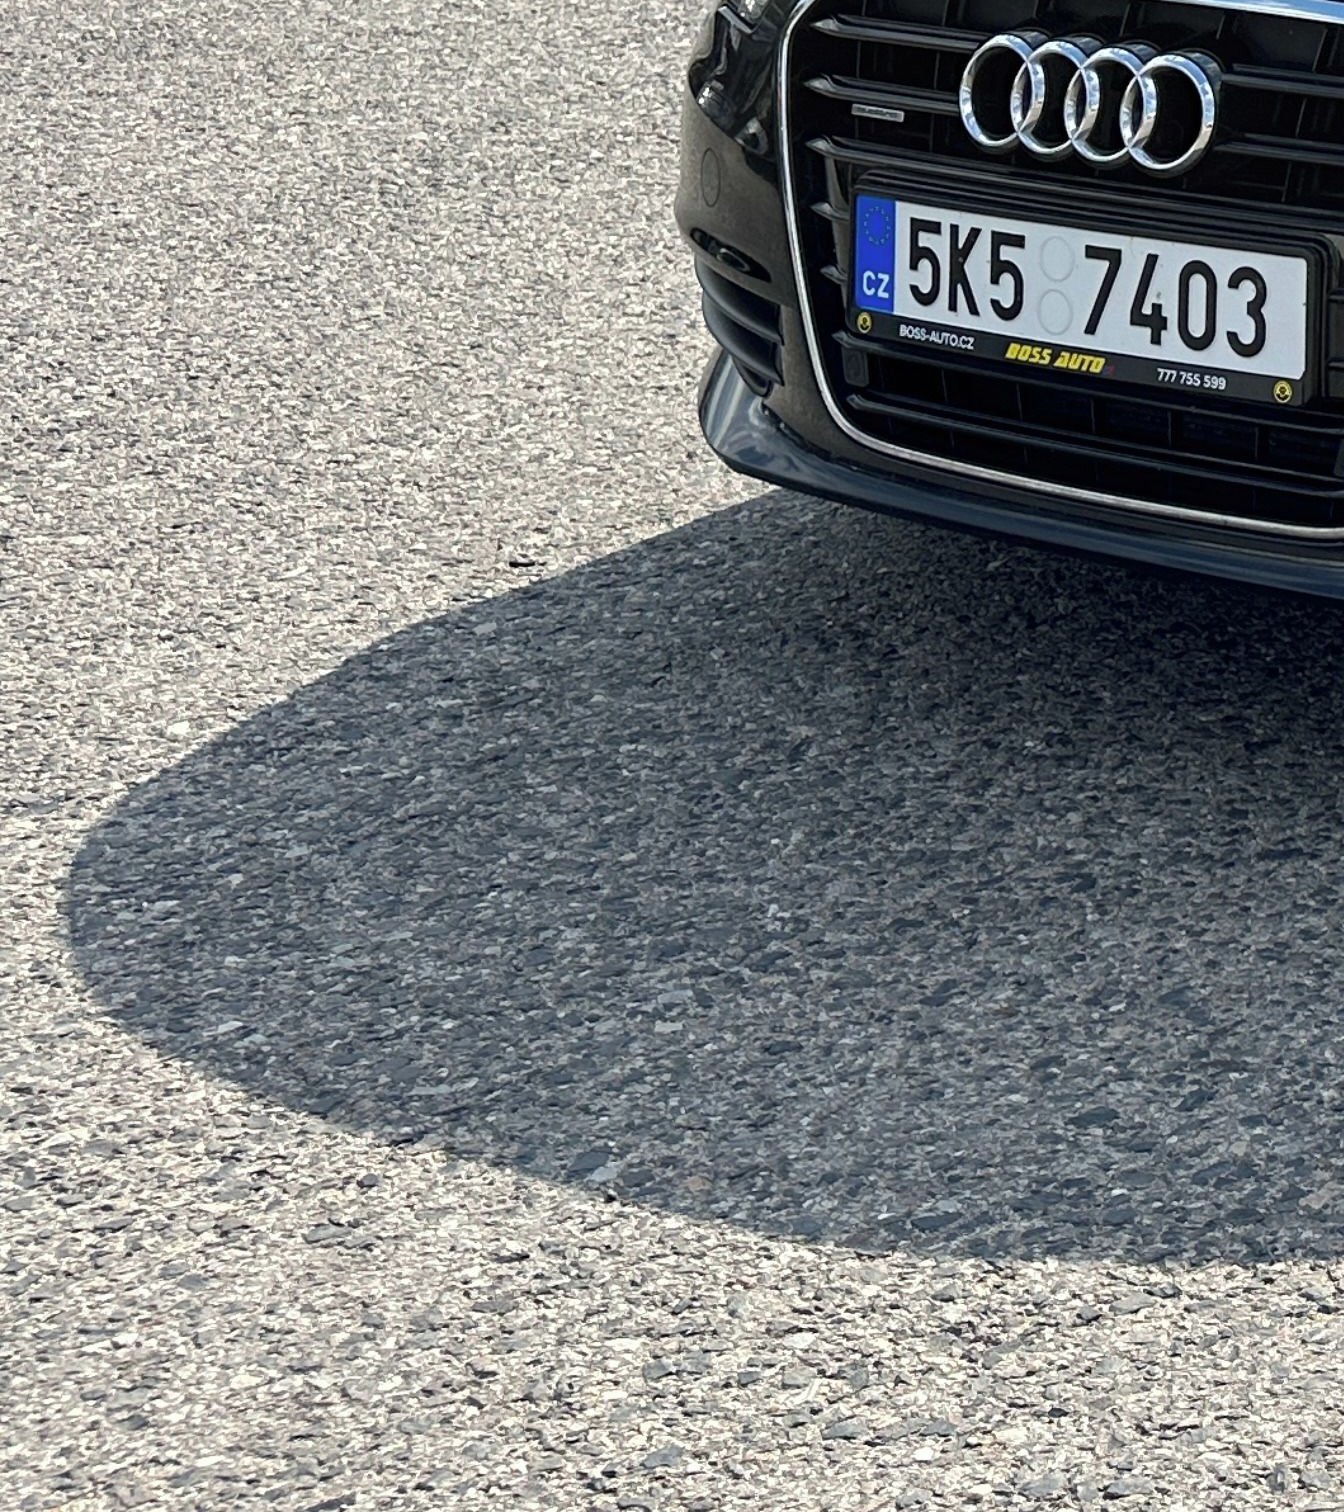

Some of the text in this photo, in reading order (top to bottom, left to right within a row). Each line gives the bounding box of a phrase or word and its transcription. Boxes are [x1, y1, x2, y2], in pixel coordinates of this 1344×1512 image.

[862, 270, 889, 299] CZ
[909, 217, 1268, 357] 5K5 7403
[900, 324, 975, 350] BOSS-AUTO.CZ
[1005, 342, 1105, 374] BOSS AUTO
[1157, 367, 1227, 391] 777 755 599
